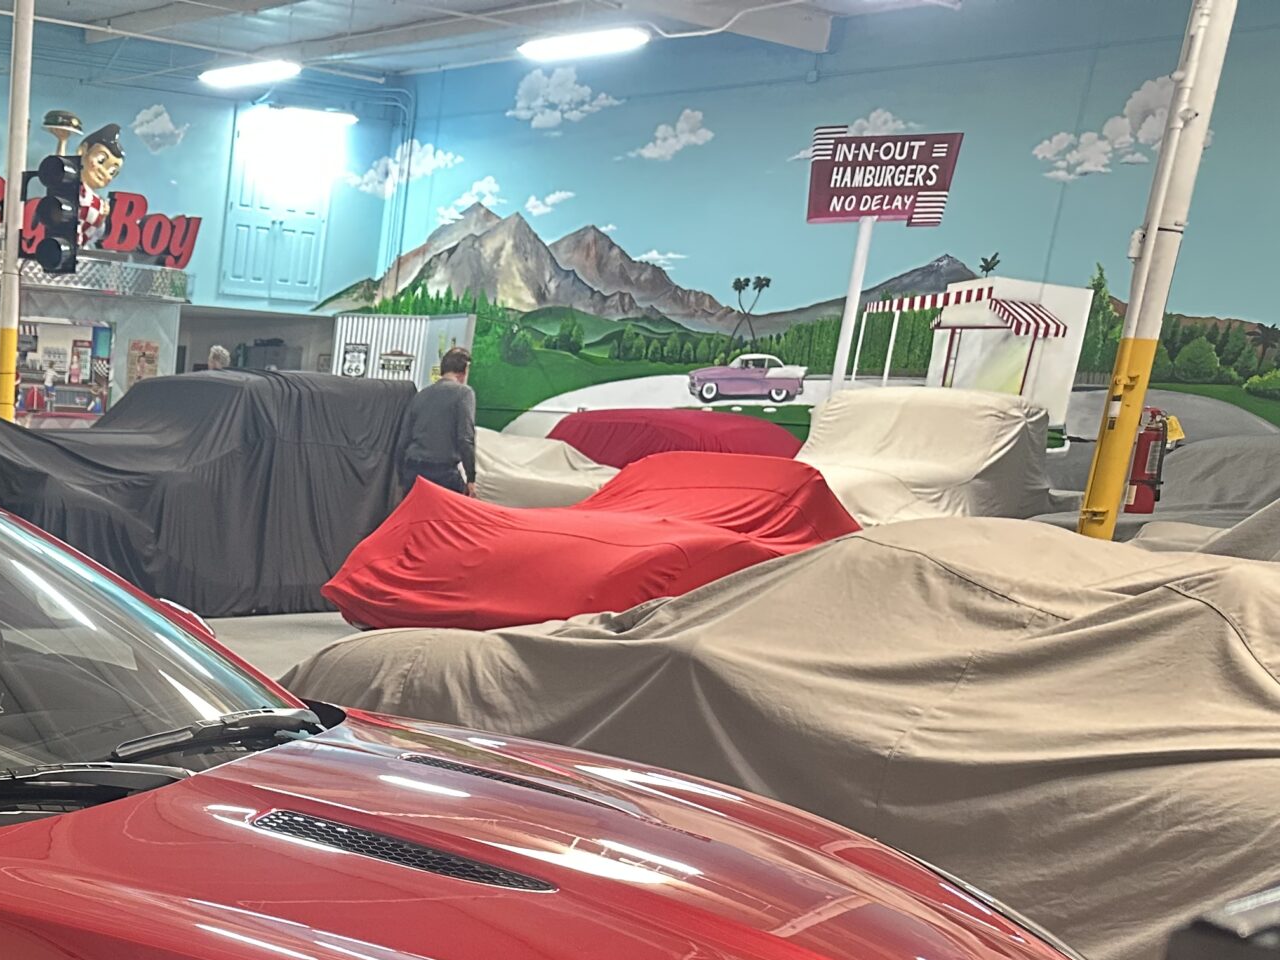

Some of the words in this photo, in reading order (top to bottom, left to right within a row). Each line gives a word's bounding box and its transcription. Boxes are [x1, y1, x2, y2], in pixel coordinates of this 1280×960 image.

[835, 141, 926, 162] IN-N-OUT
[830, 164, 939, 188] HAMBURGERS
[829, 194, 856, 212] NO
[859, 194, 914, 211] DELAY
[101, 191, 202, 270] Boy
[347, 364, 361, 374] 66
